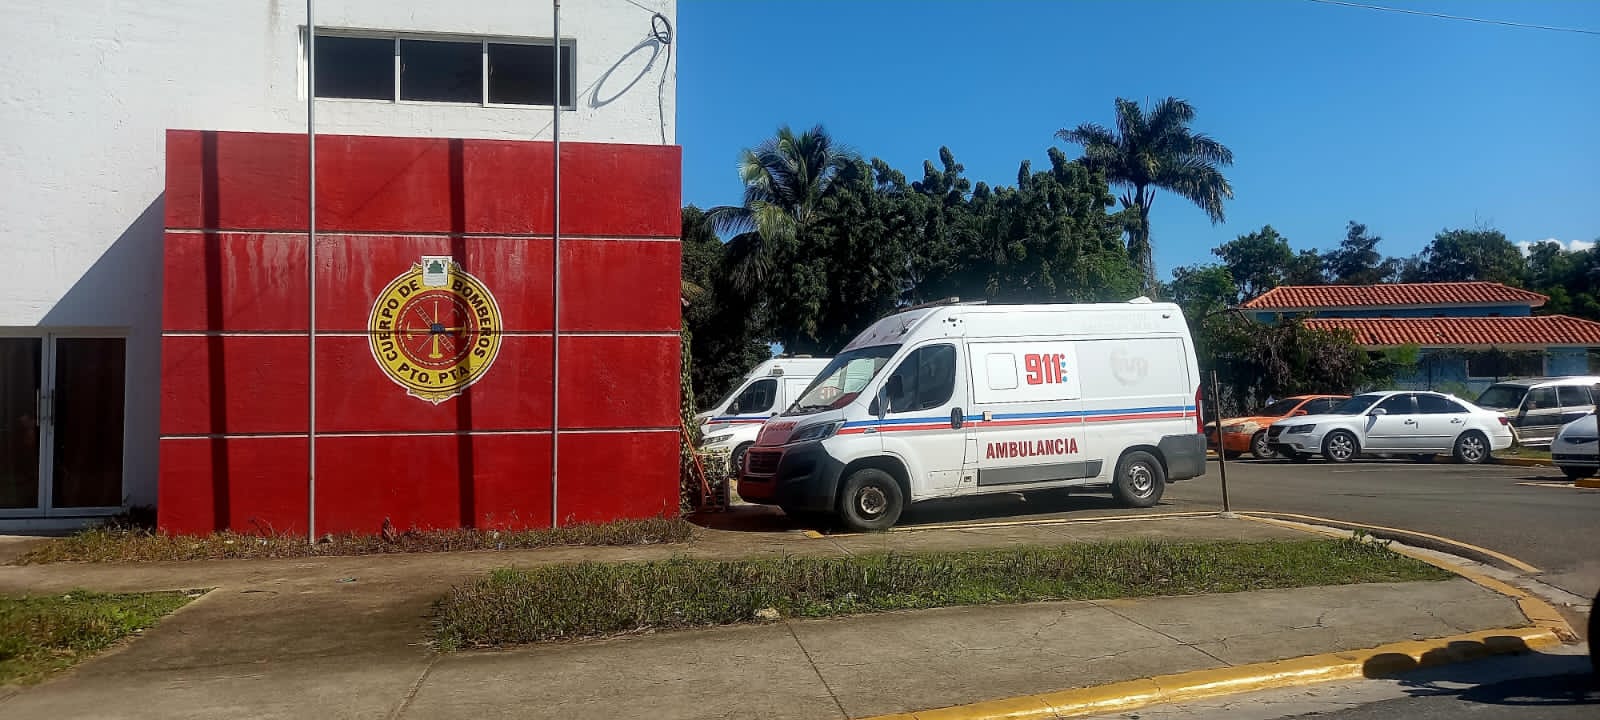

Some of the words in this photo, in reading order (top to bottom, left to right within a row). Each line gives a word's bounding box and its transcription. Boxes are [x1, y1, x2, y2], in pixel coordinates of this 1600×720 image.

[379, 298, 399, 362] CUERPO
[398, 279, 421, 298] DE
[452, 279, 492, 359] BOMBEROS
[1024, 353, 1062, 385] 911
[986, 437, 1078, 459] AMBULANCIA
